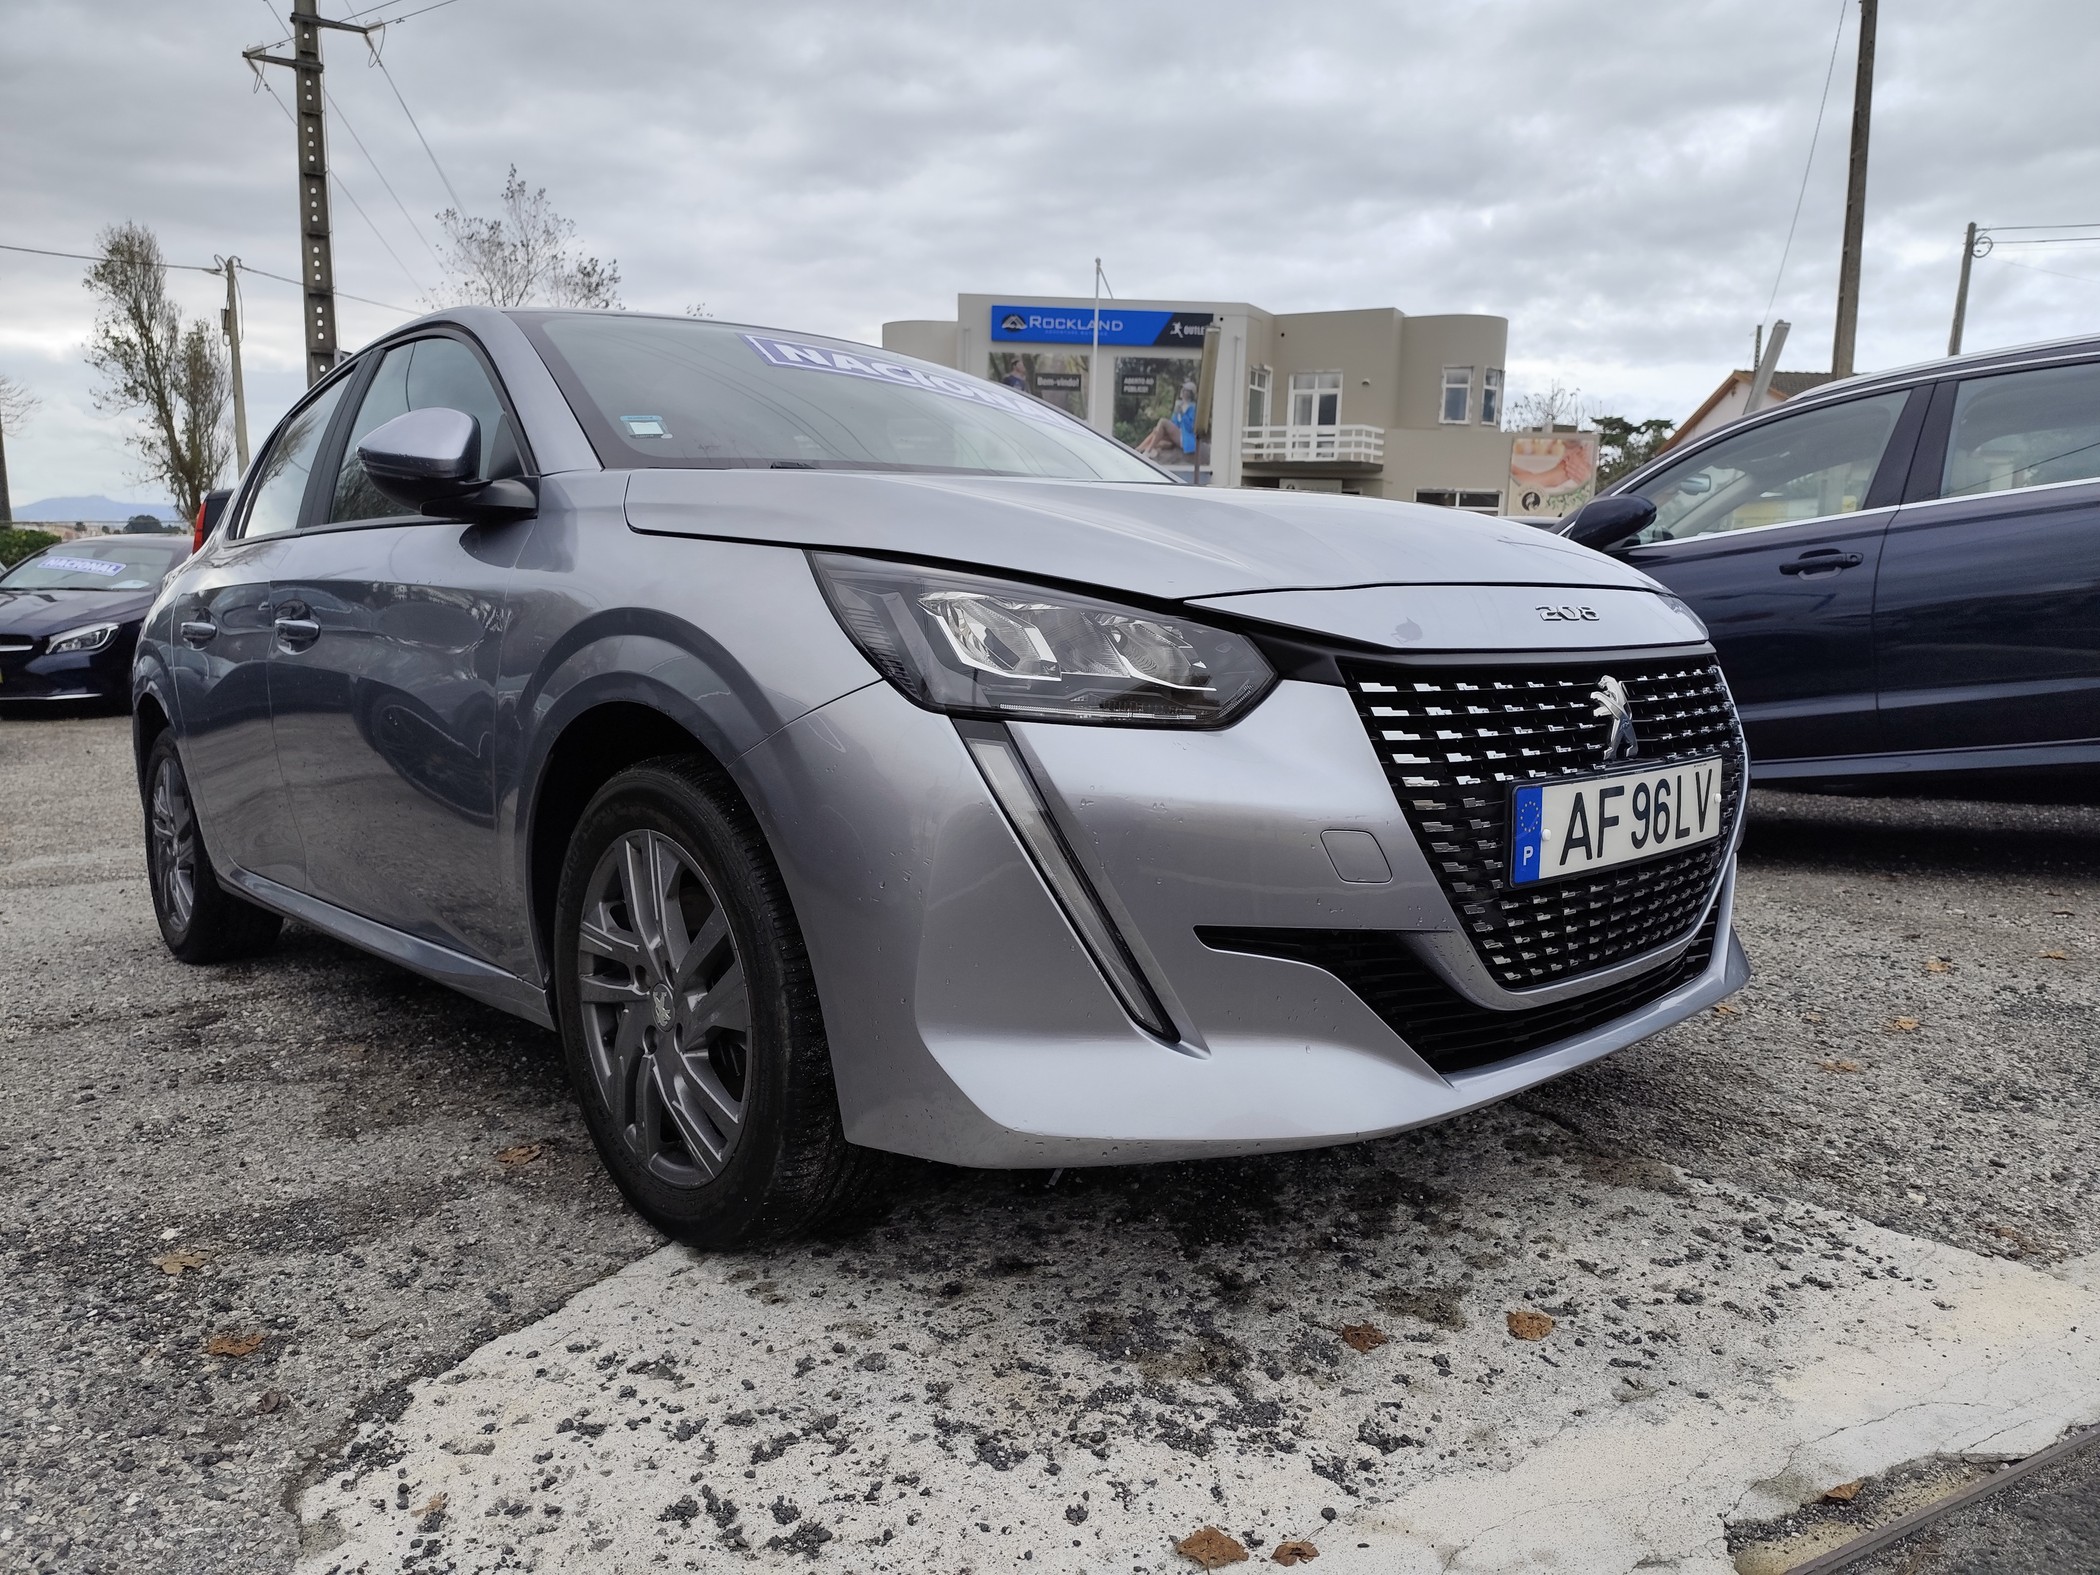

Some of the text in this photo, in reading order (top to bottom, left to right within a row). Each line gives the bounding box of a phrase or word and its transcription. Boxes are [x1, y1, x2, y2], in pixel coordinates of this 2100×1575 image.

[1029, 315, 1124, 332] ROCKLAND
[1183, 325, 1205, 336] OUTLE
[43, 558, 118, 573] NACIONAL
[1535, 604, 1601, 622] 208
[1559, 768, 1713, 866] AF 96 LV
[1522, 845, 1535, 867] P
